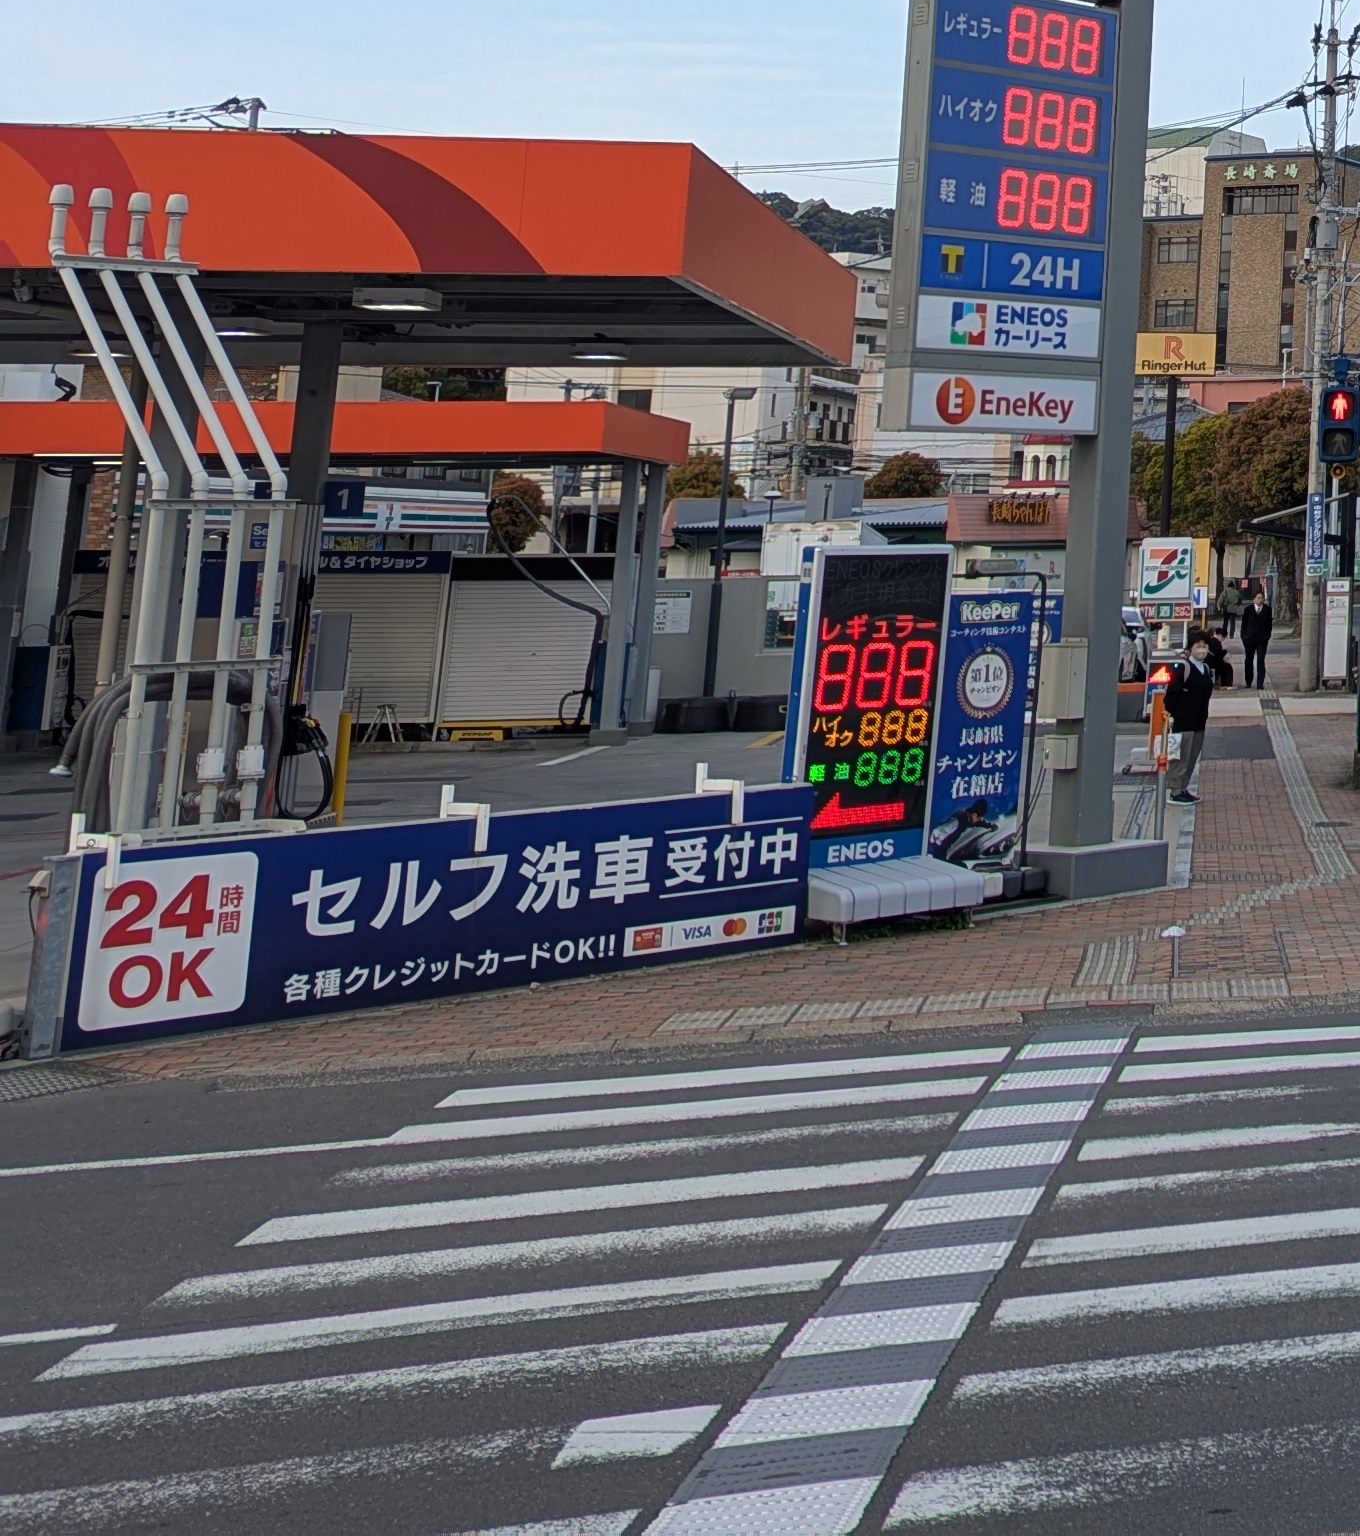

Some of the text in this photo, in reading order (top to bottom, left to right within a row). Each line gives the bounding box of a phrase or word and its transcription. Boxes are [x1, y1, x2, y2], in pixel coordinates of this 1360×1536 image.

[943, 6, 1101, 76] レギュラー 888
[938, 87, 1097, 155] ハイオク 888
[938, 168, 1093, 234] 軽油 888
[1009, 252, 1081, 291] 24H
[995, 304, 1069, 328] ENEOS
[994, 327, 1067, 350] カーリース
[980, 389, 1075, 424] EneKey
[337, 488, 350, 511] 1
[821, 614, 937, 641] レギュラー
[961, 600, 1021, 623] KeePer
[814, 640, 936, 712] 888
[970, 663, 1004, 683] 第1位
[858, 708, 929, 748] 888
[959, 724, 1004, 747] 長崎県
[854, 747, 925, 787] 888
[936, 749, 1018, 774] チャンピオン
[950, 771, 1005, 800] 在籍店
[827, 838, 895, 864] ENEOS
[292, 827, 798, 938] セルフ洗車 受付中
[100, 875, 214, 950] 24
[218, 883, 245, 938] 時間
[681, 924, 712, 941] VISA
[107, 948, 214, 1011] OK
[283, 932, 617, 1004] 各種クレジットカードOK!!
